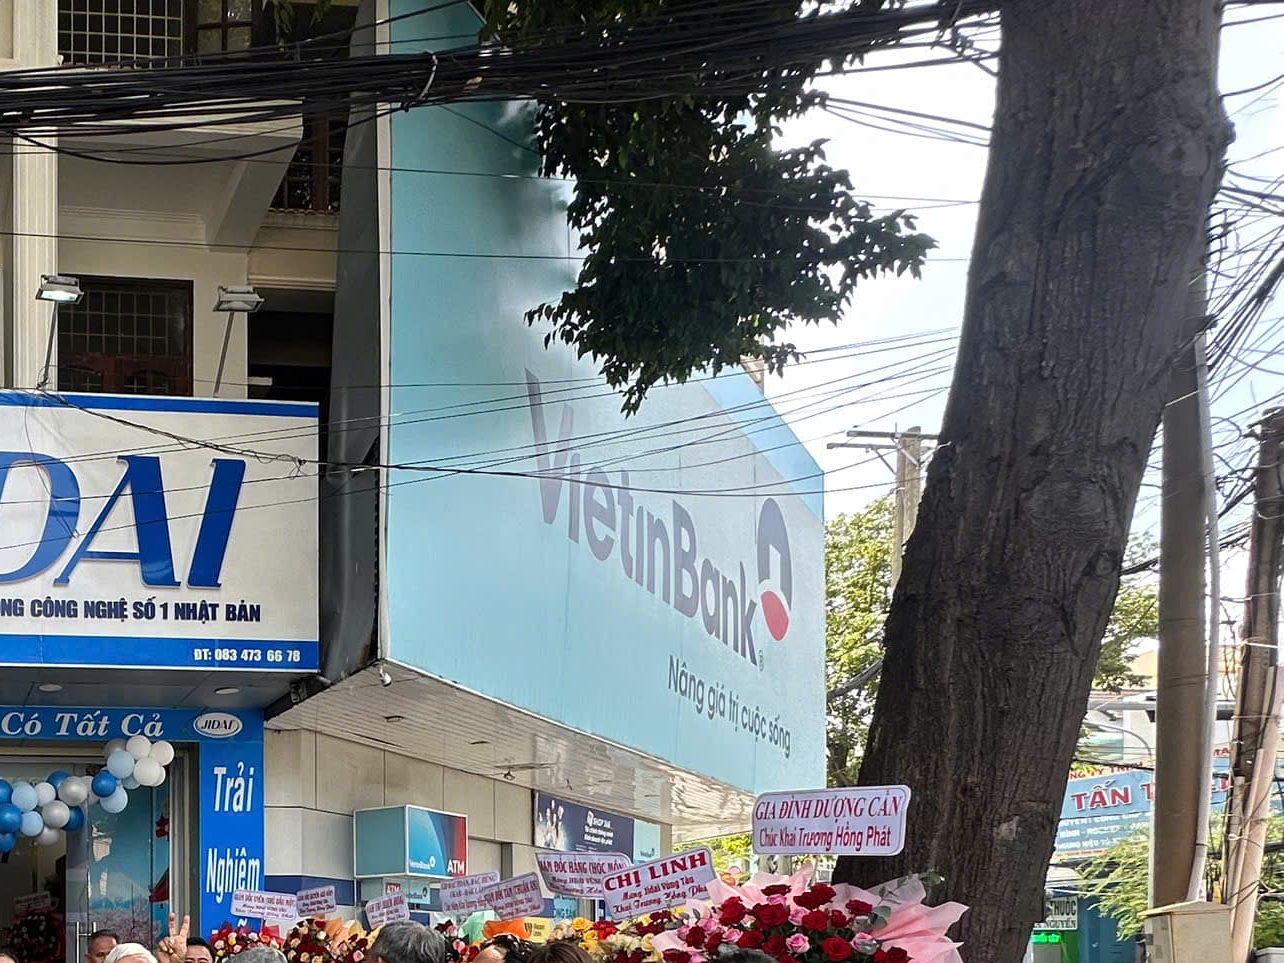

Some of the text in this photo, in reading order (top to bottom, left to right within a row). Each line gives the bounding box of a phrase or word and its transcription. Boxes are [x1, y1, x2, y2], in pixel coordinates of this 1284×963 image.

[523, 367, 757, 667] VietinBank
[30, 596, 78, 620] CÔNG
[84, 598, 129, 624] NGHỆ
[132, 596, 157, 621] SỐ
[160, 601, 170, 621] 1
[174, 600, 220, 625] NHẬT
[225, 600, 261, 623] BẢN
[215, 648, 238, 662] 083
[241, 648, 262, 662] 473
[267, 649, 283, 662] 66
[286, 649, 302, 663] 78
[668, 654, 791, 759] Nâng giá trị cuộc sống
[1, 711, 43, 736] Có
[55, 710, 111, 737] Tất
[121, 712, 165, 738] Cả
[213, 760, 255, 813] Trải
[1071, 780, 1132, 811] TẤN
[755, 800, 777, 820] GIA
[779, 795, 811, 820] ĐÌNH
[813, 796, 865, 824] DƯỢNG
[759, 826, 779, 848] Chúc
[779, 826, 798, 848] Khai
[836, 820, 864, 852] Hồng
[866, 825, 891, 848] Phát
[447, 859, 465, 875] ATM
[604, 850, 708, 892] CHỊ LINH
